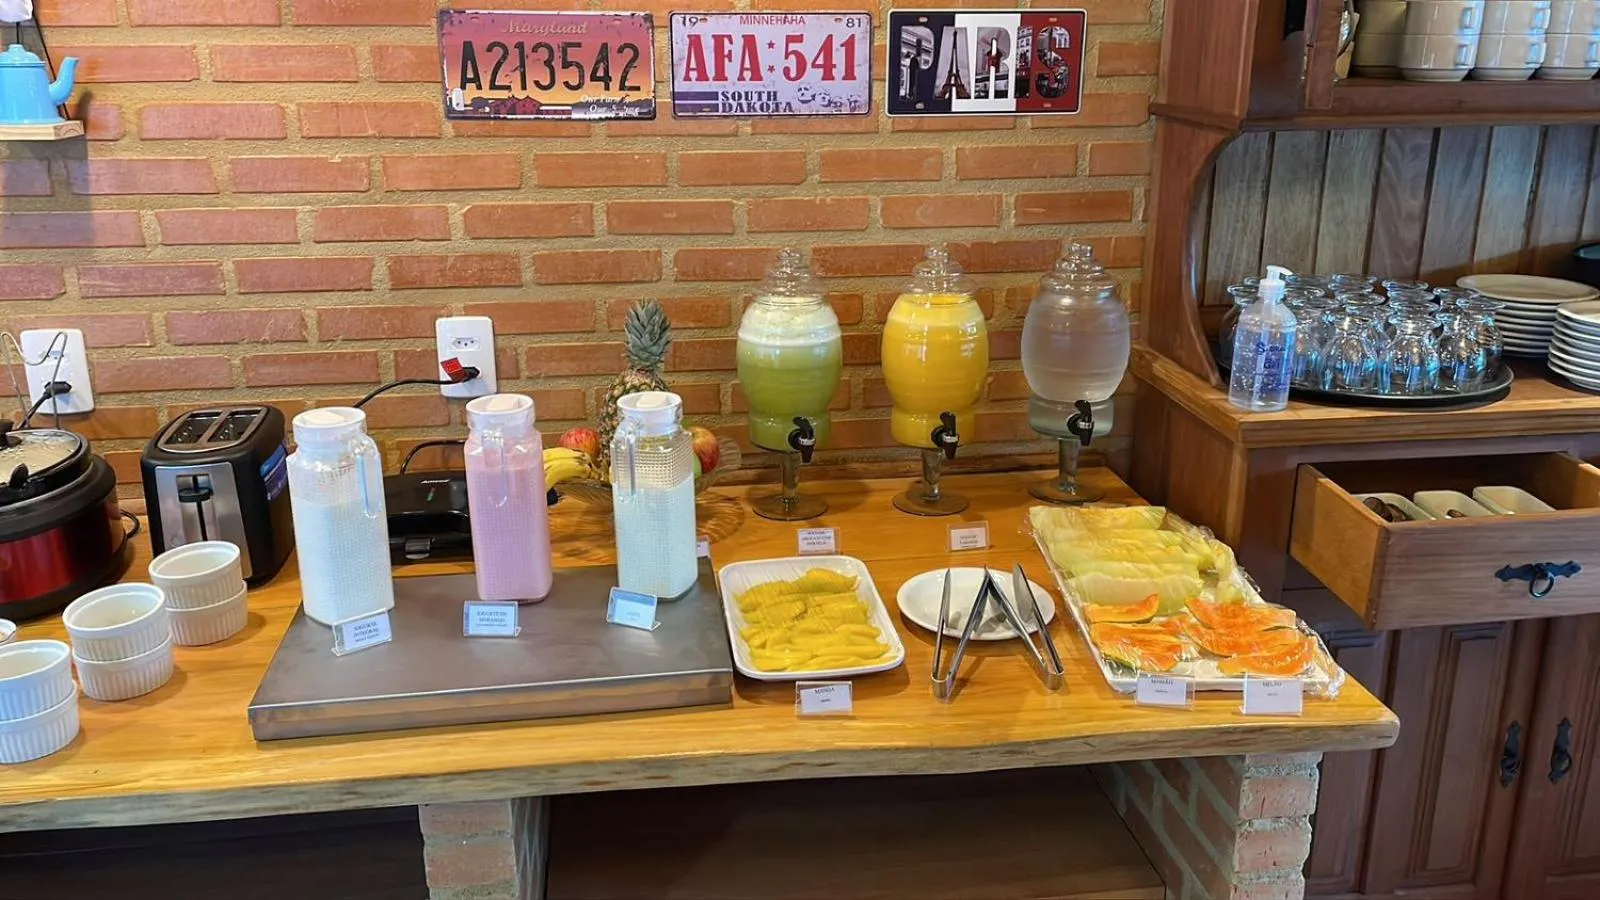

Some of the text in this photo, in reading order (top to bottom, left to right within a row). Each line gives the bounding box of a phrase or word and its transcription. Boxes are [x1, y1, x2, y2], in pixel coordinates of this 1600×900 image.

[502, 19, 589, 36] Maryland
[680, 14, 863, 29] 19 MINNEHAHA 81
[460, 40, 641, 92] A213542
[683, 33, 858, 82] AFA 541
[899, 25, 1072, 100] PARIS
[720, 90, 778, 102] SOUTH
[720, 102, 793, 114] DAKOTA
